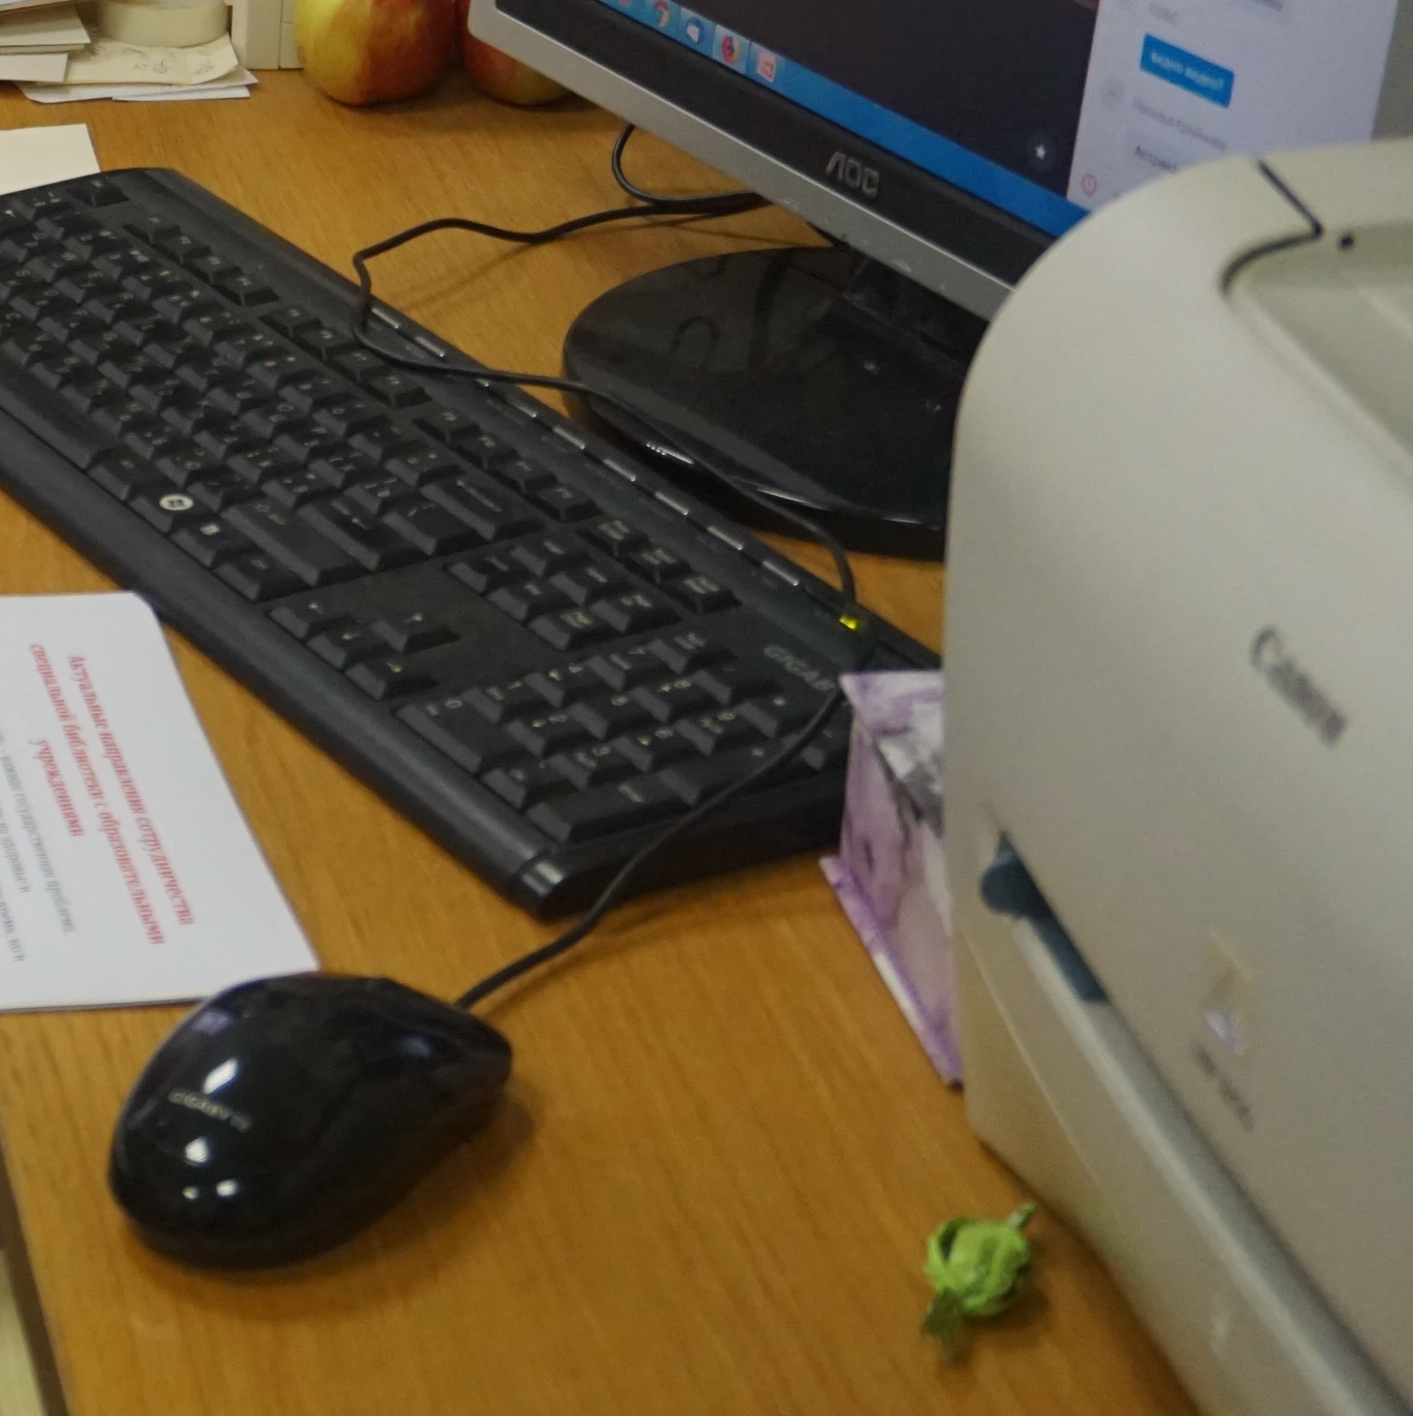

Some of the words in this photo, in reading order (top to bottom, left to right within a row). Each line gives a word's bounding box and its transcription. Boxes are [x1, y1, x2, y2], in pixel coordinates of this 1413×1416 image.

[826, 151, 880, 200] AOC
[30, 644, 76, 723] специальной
[62, 723, 104, 800] библиотеки
[98, 811, 165, 945] образовательными
[35, 739, 84, 837] учреждениями
[68, 655, 109, 730] Актуальные
[98, 731, 146, 815] направления
[136, 816, 195, 925] сотрудничества
